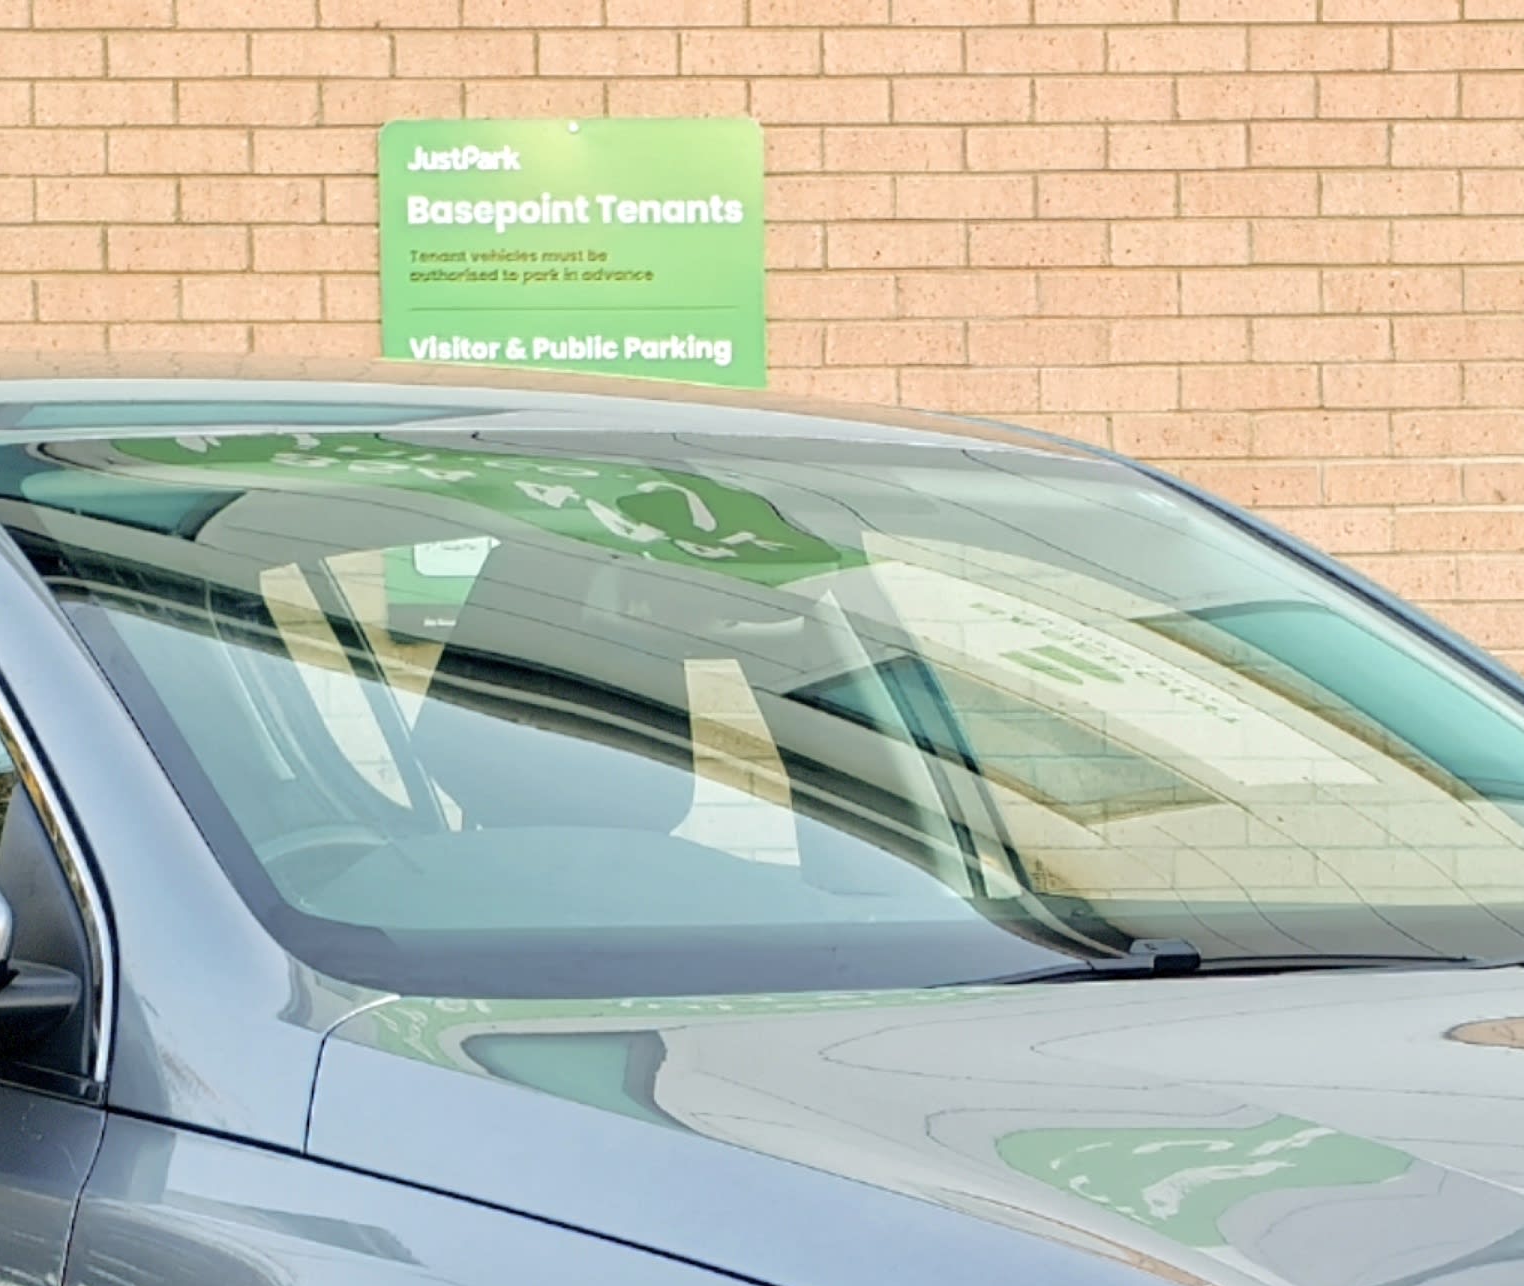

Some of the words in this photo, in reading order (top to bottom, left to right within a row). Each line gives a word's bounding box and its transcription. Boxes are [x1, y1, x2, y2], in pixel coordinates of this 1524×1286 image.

[407, 145, 522, 171] JustPark
[407, 192, 590, 232] Basepoint
[595, 195, 744, 224] Tenants
[410, 249, 467, 263] Tenant
[470, 248, 537, 263] vehicles
[542, 250, 583, 262] must
[587, 248, 608, 262] be
[409, 268, 499, 283] authorised
[502, 269, 519, 281] to
[523, 268, 559, 284] park
[563, 268, 578, 281] in
[582, 268, 654, 281] advance
[409, 336, 501, 361] Visitor
[506, 337, 527, 360] &
[532, 336, 618, 361] Public
[624, 336, 733, 367] Parking
